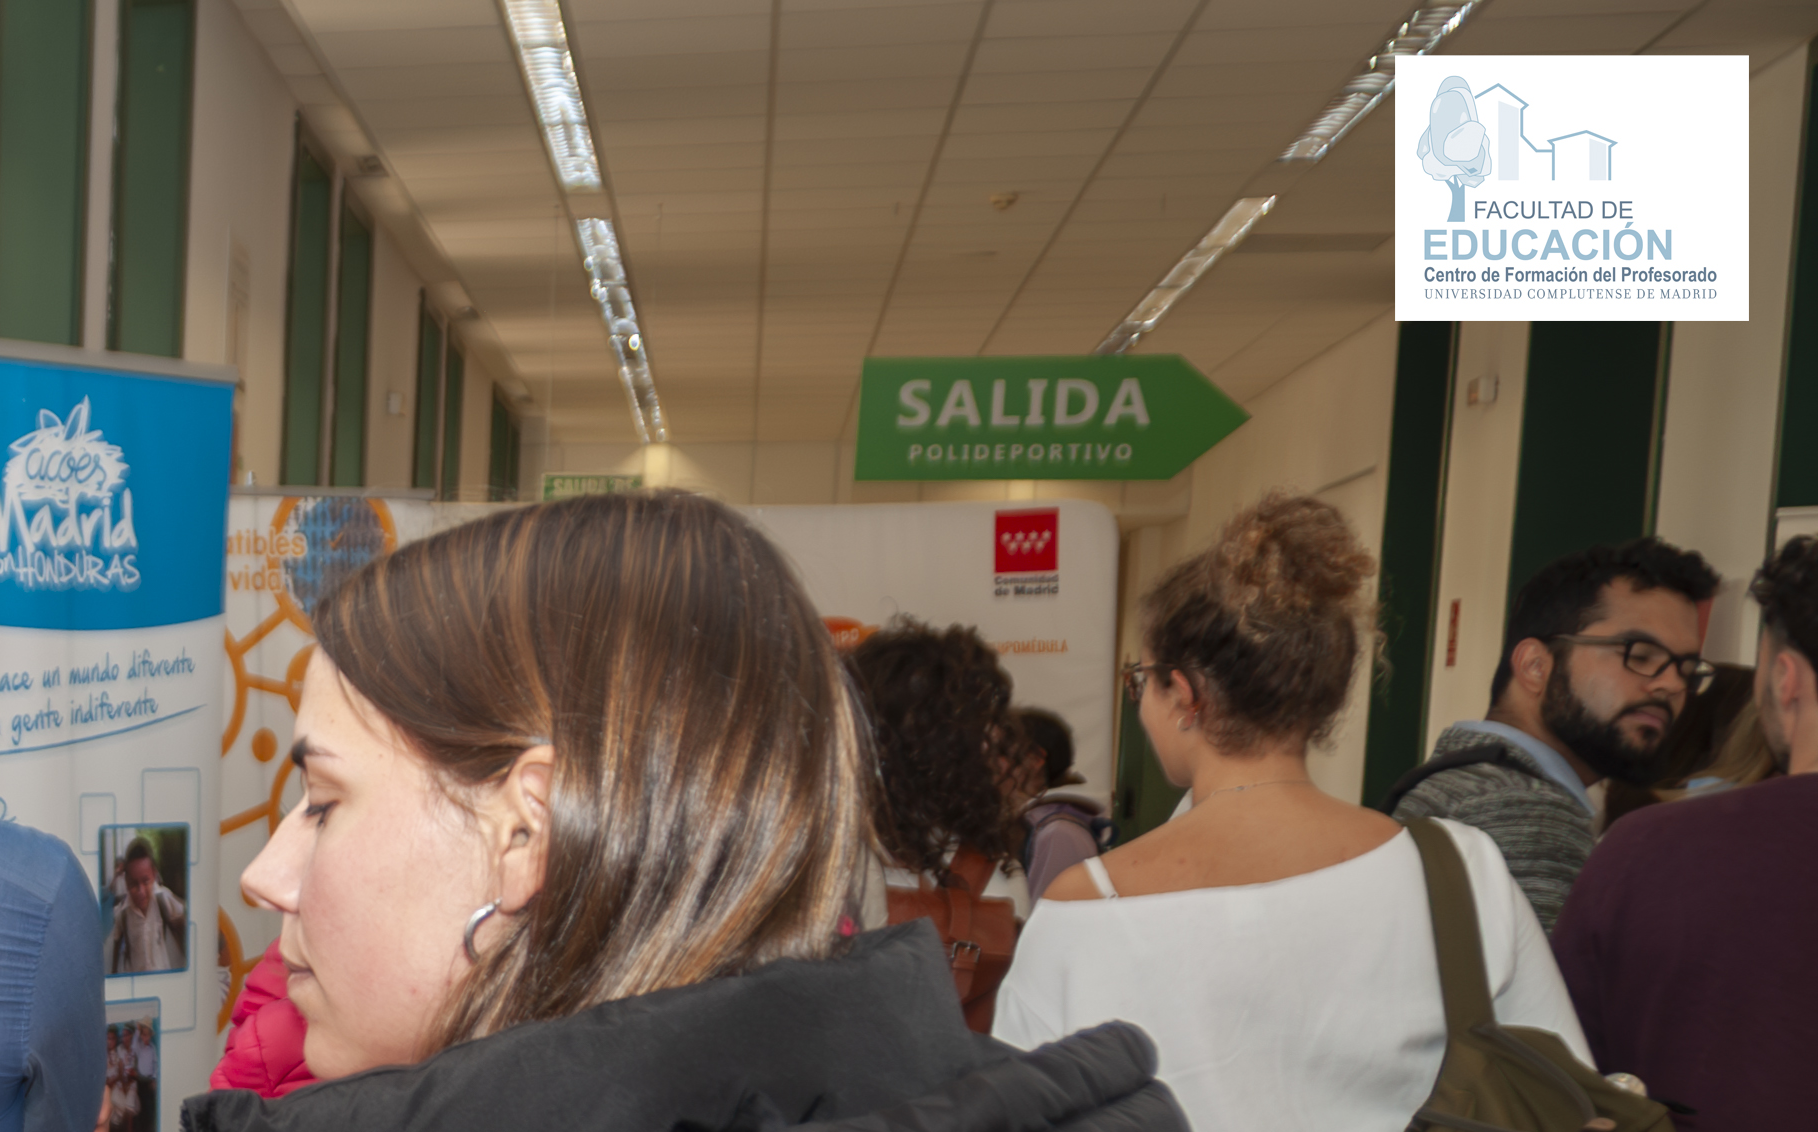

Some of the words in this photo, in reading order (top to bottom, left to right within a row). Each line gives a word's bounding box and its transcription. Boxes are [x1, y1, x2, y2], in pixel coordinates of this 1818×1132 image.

[896, 377, 1151, 427] SALIDA
[25, 446, 107, 487] acoes
[908, 443, 1133, 463] POLIDEPORTIVO
[228, 564, 283, 591] vida
[994, 574, 1059, 585] Comunidad
[994, 585, 1010, 597] de
[1014, 584, 1059, 596] Madrid
[42, 664, 61, 688] un
[68, 652, 120, 686] mundo
[127, 646, 196, 678] diferente
[11, 698, 63, 745] gente
[70, 687, 159, 726] indiferente
